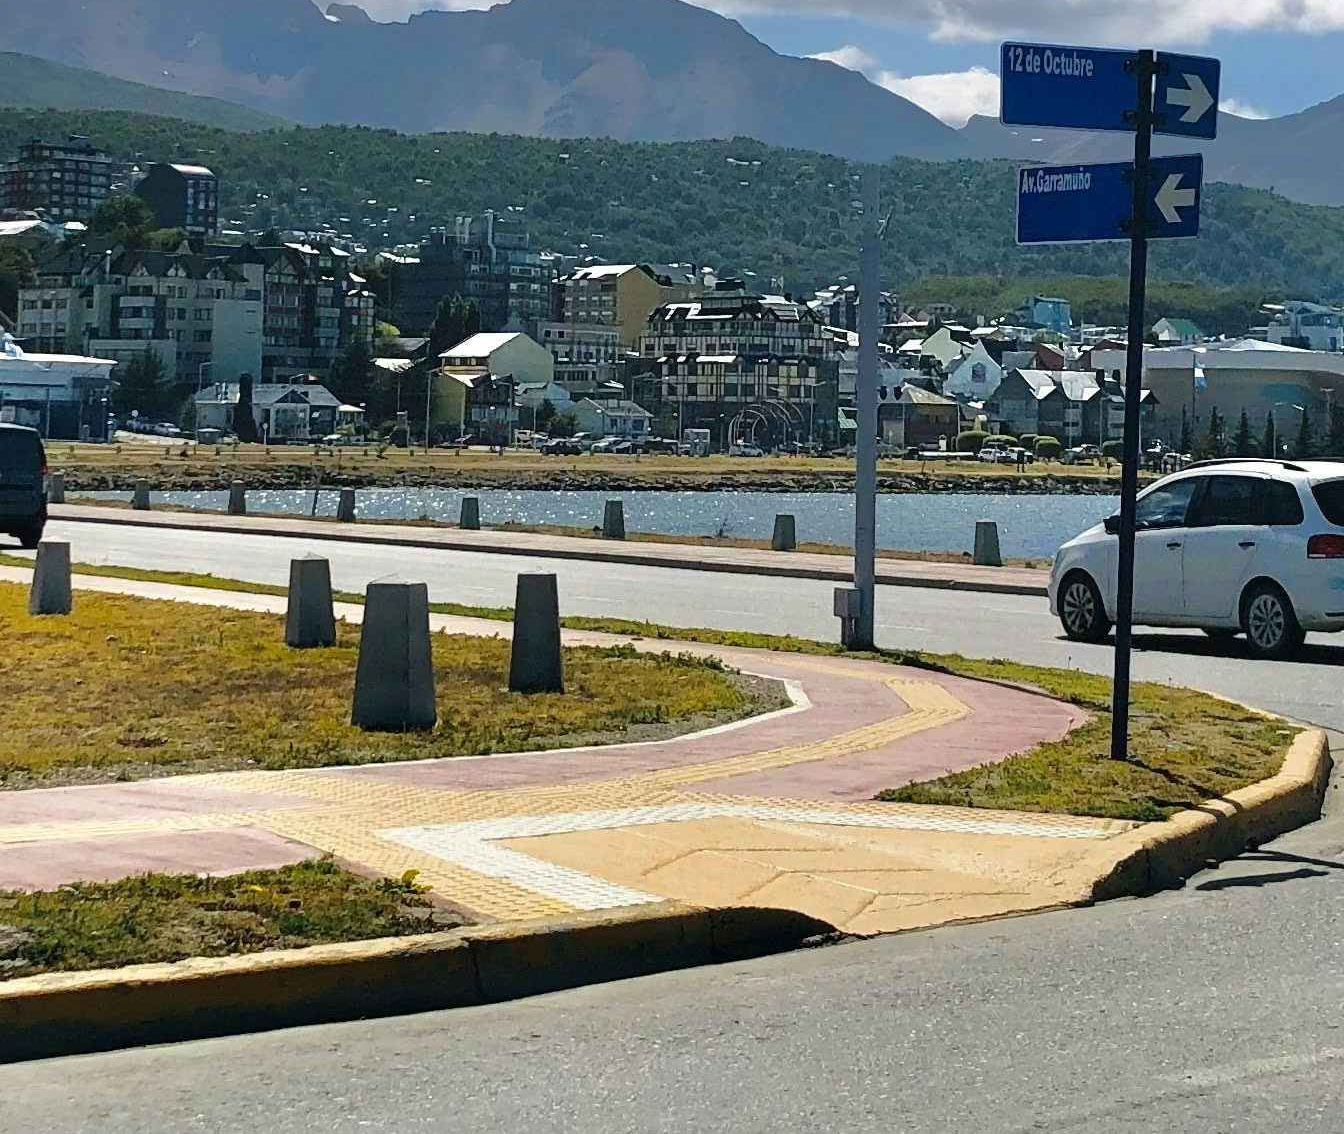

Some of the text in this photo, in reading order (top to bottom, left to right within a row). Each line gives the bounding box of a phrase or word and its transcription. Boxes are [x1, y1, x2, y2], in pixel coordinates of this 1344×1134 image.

[1008, 46, 1094, 77] 12 de Octubre
